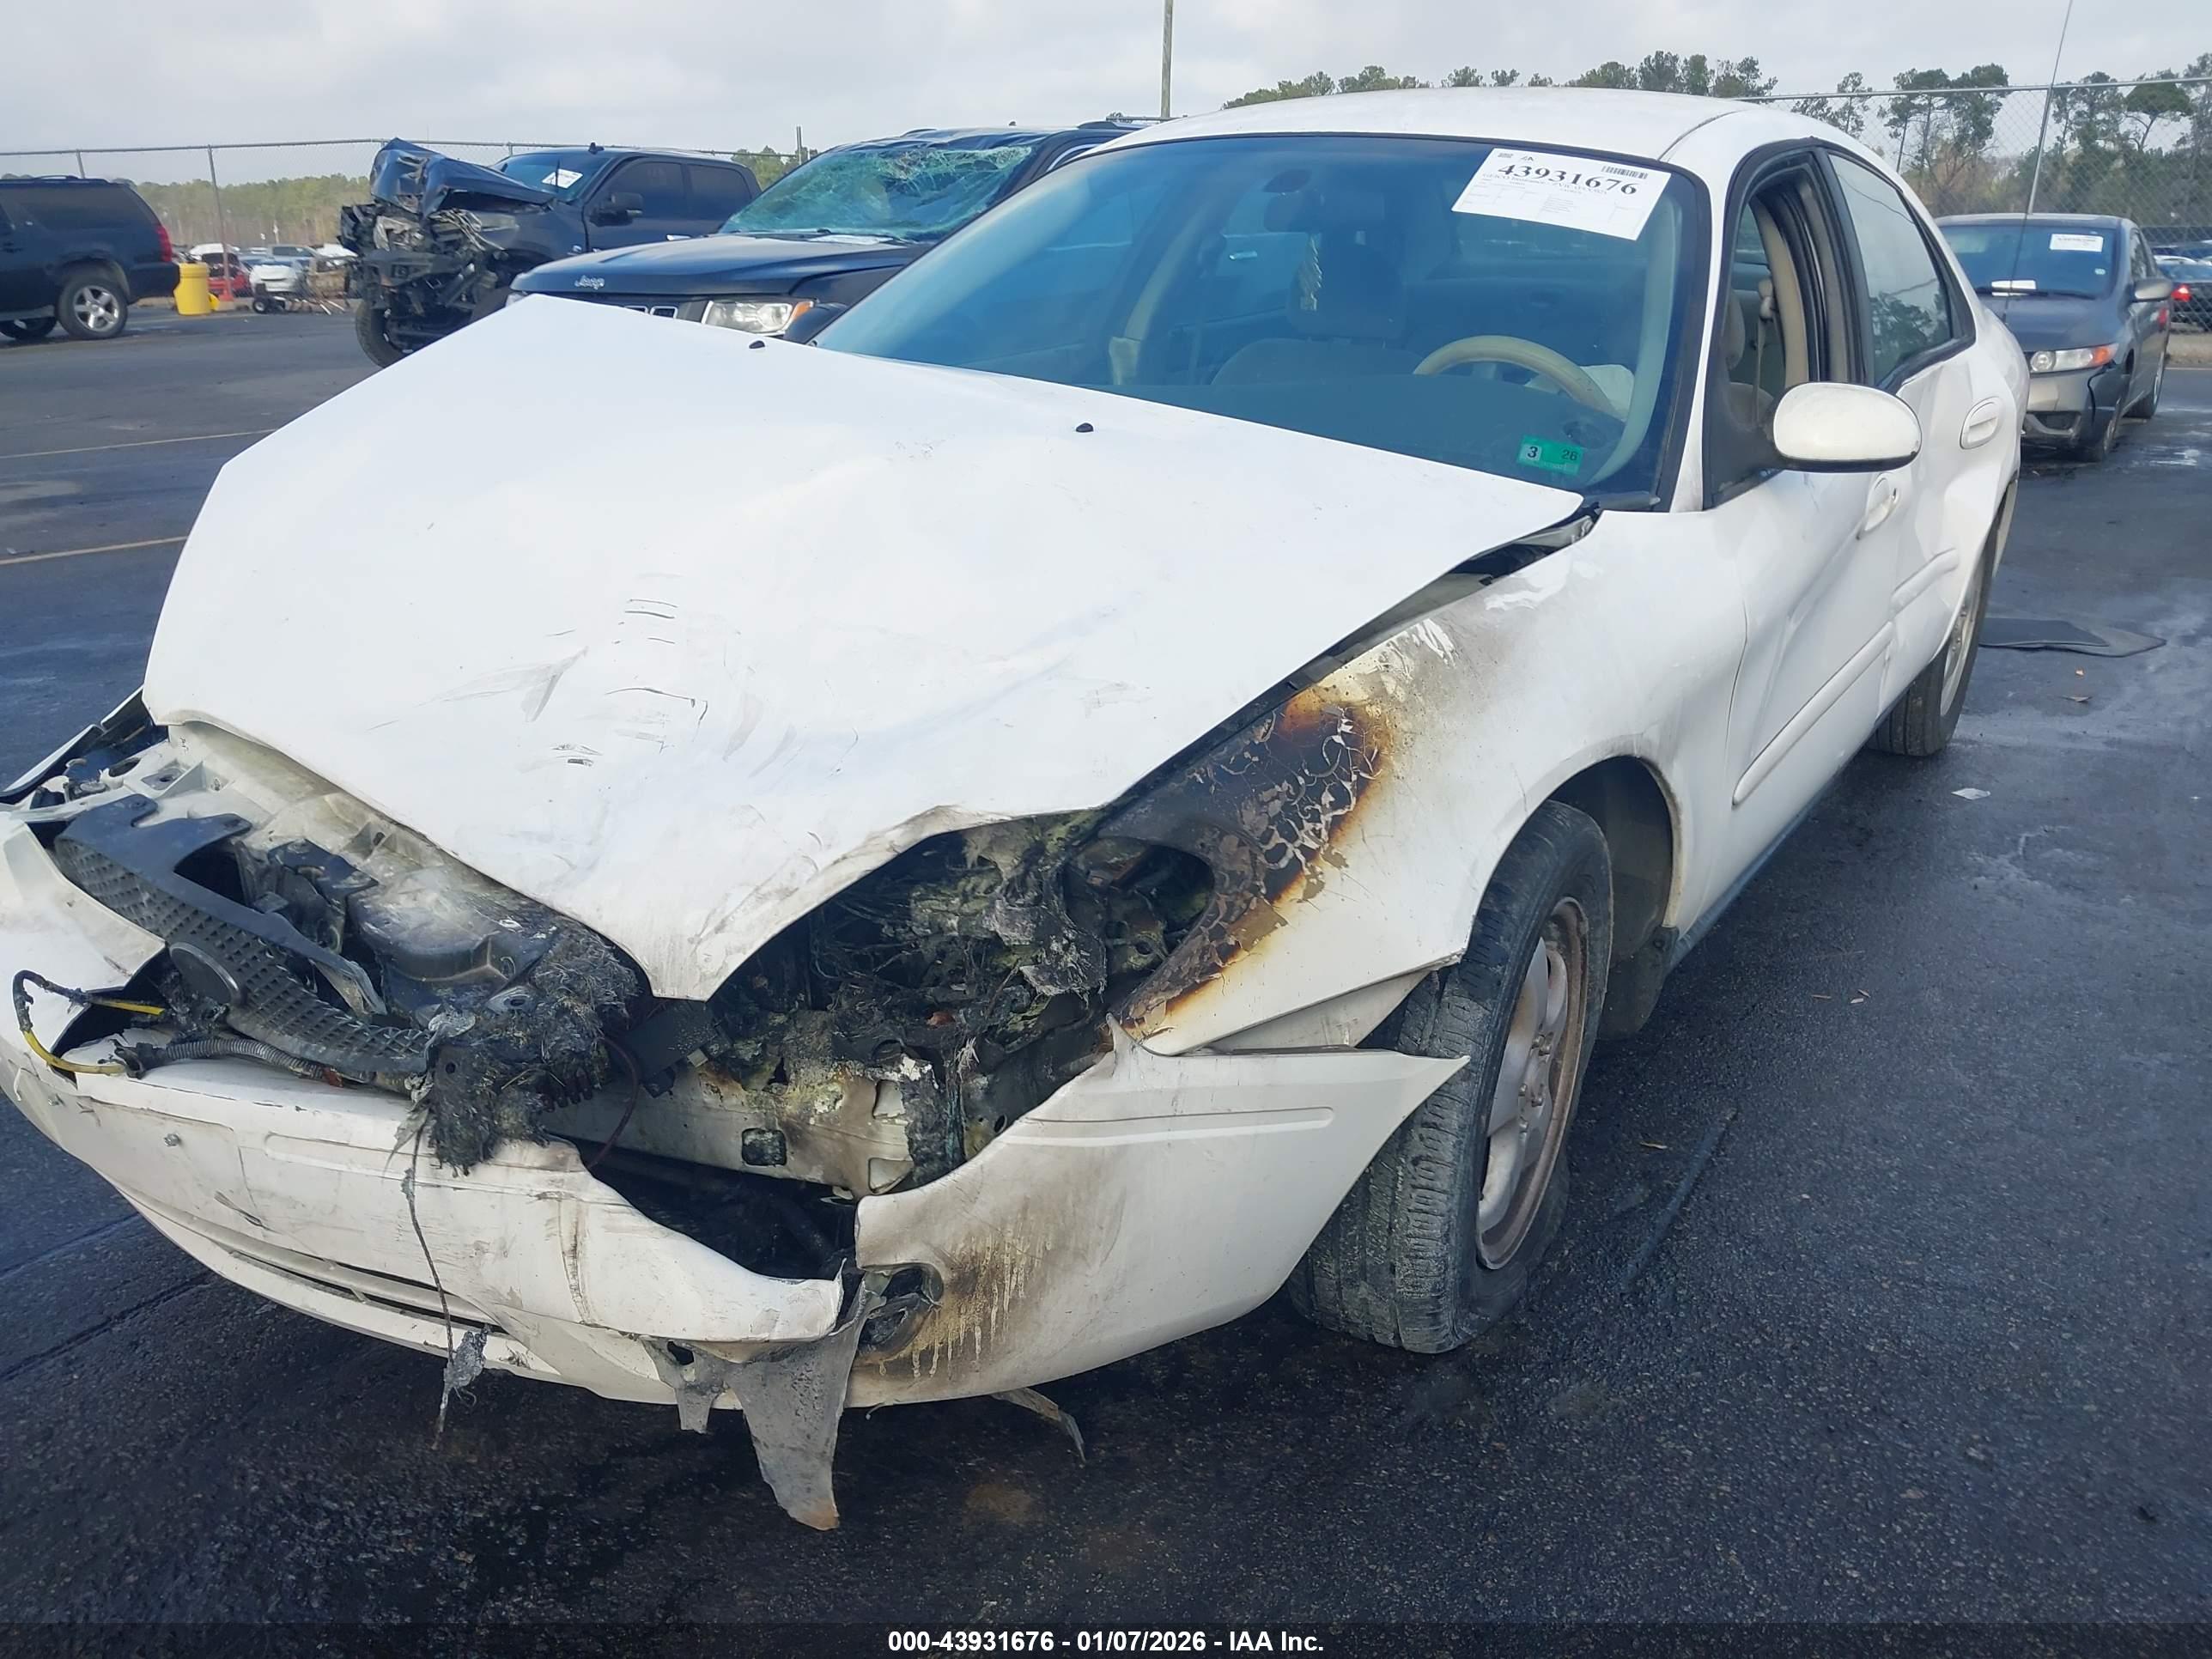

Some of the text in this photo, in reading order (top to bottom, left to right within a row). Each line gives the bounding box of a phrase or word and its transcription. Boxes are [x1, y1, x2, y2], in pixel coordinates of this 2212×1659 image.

[1498, 163, 1638, 196] 43931676
[574, 275, 605, 290] Jeep
[1527, 446, 1578, 461] 3 26
